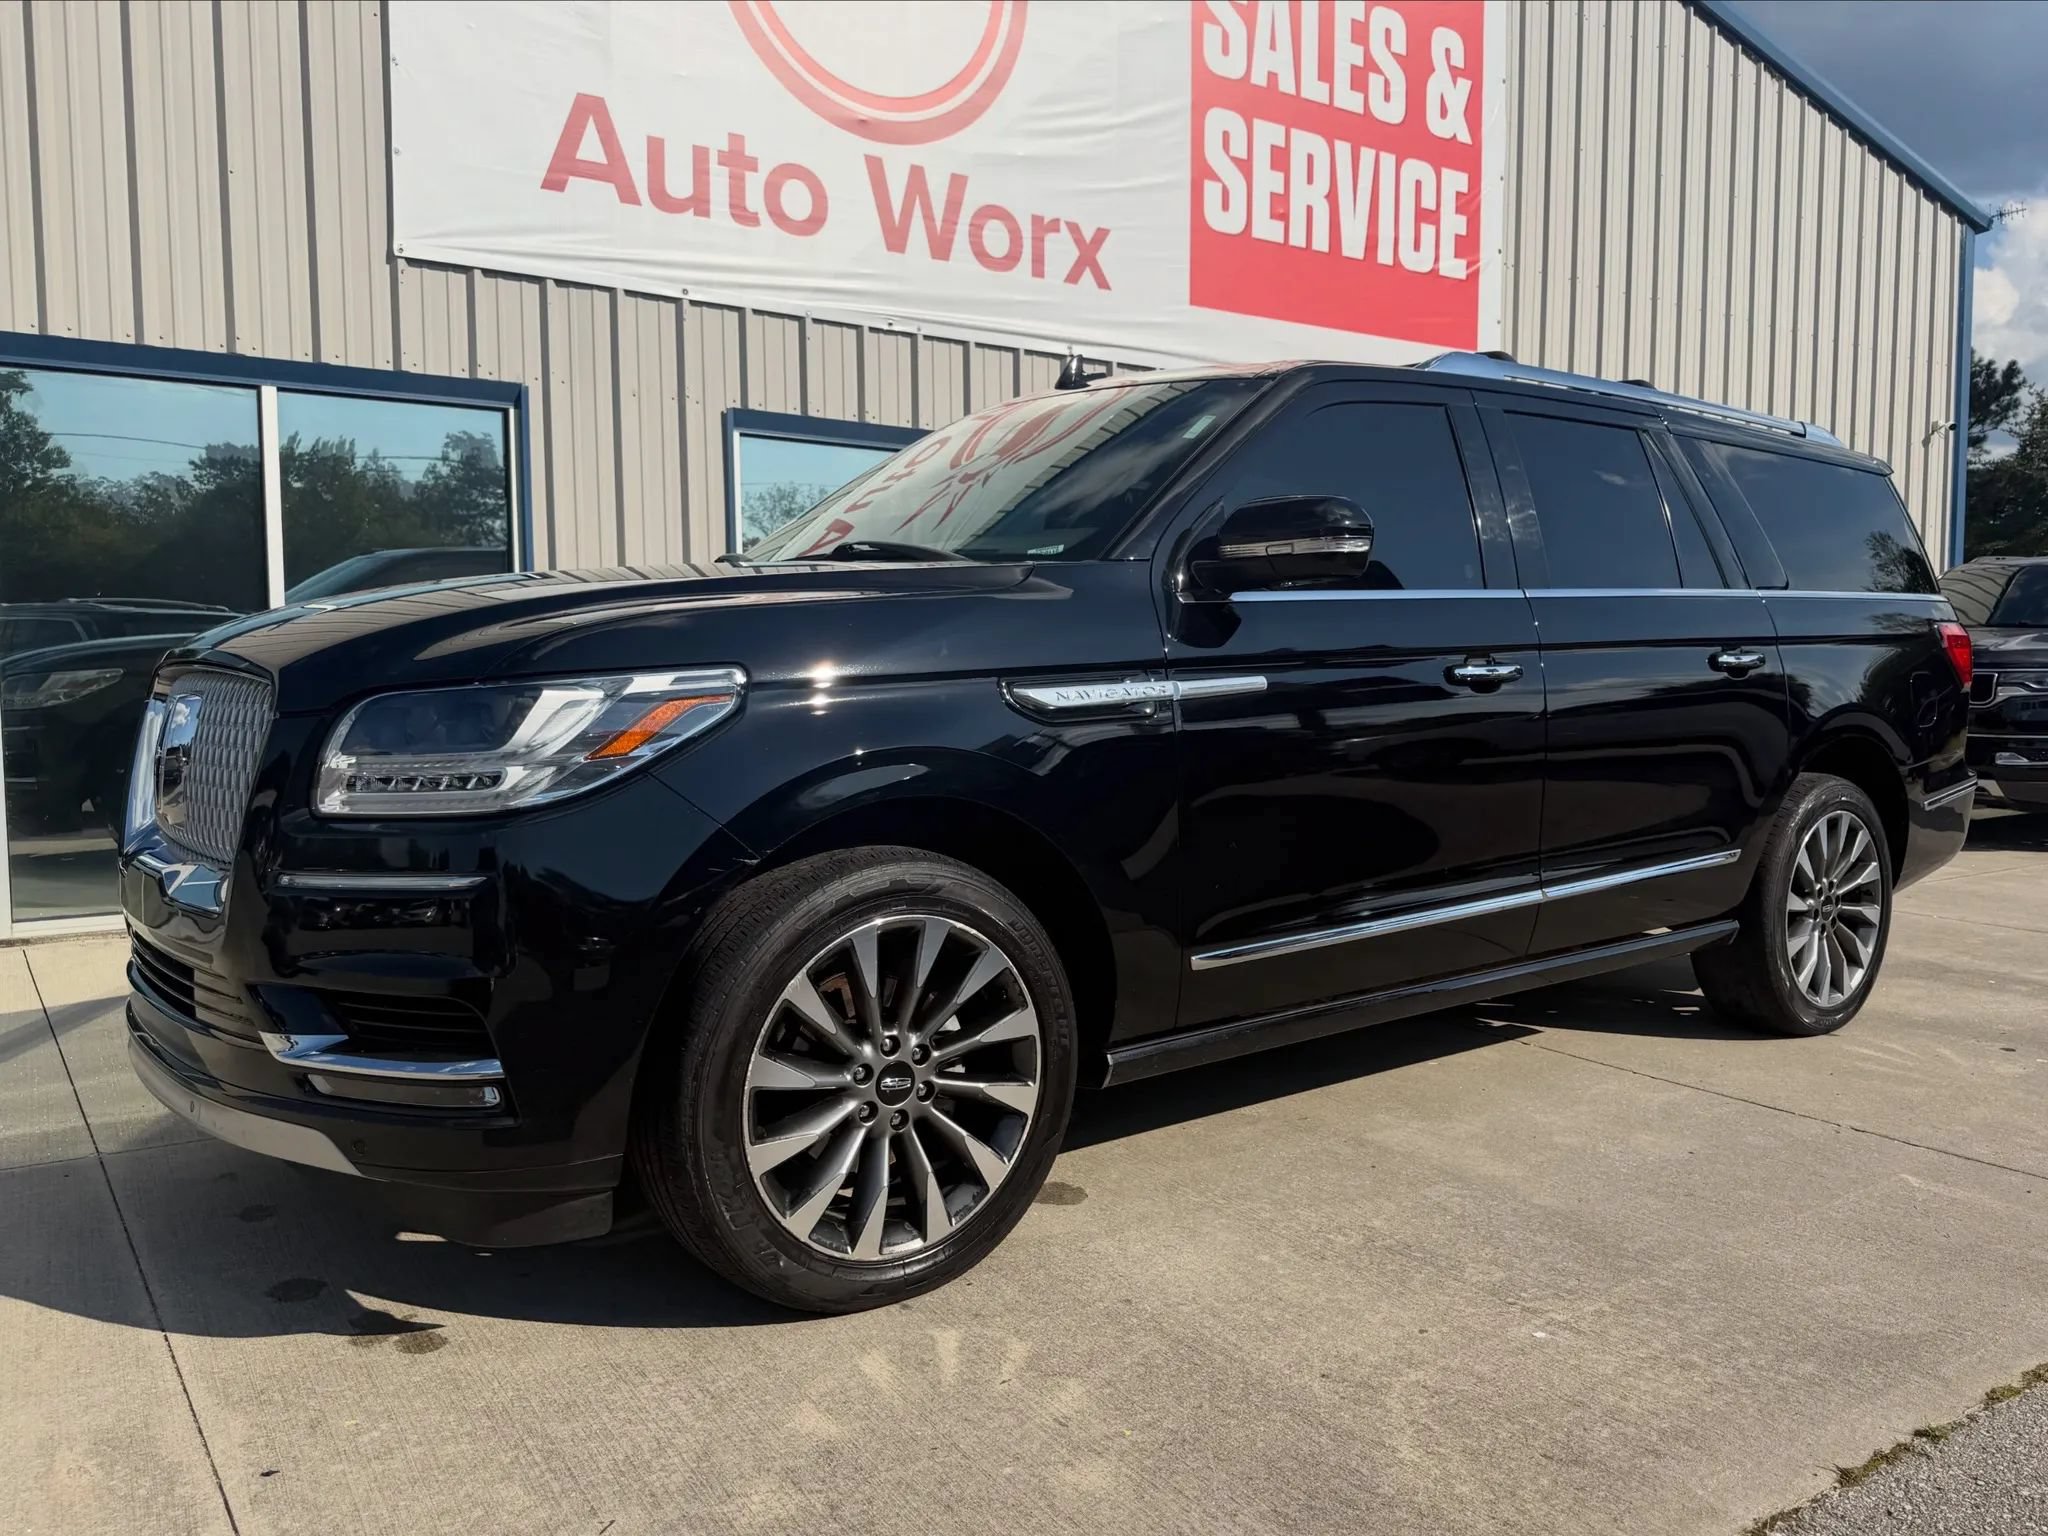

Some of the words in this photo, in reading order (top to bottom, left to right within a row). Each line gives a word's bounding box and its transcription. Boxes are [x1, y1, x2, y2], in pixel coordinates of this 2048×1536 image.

[1203, 0, 1407, 125] SALES
[1426, 26, 1473, 145] &
[540, 92, 828, 237] Auto
[864, 153, 1112, 291] Worx
[1203, 106, 1469, 280] SERVICE
[1055, 685, 1168, 702] NAVIGATOR
